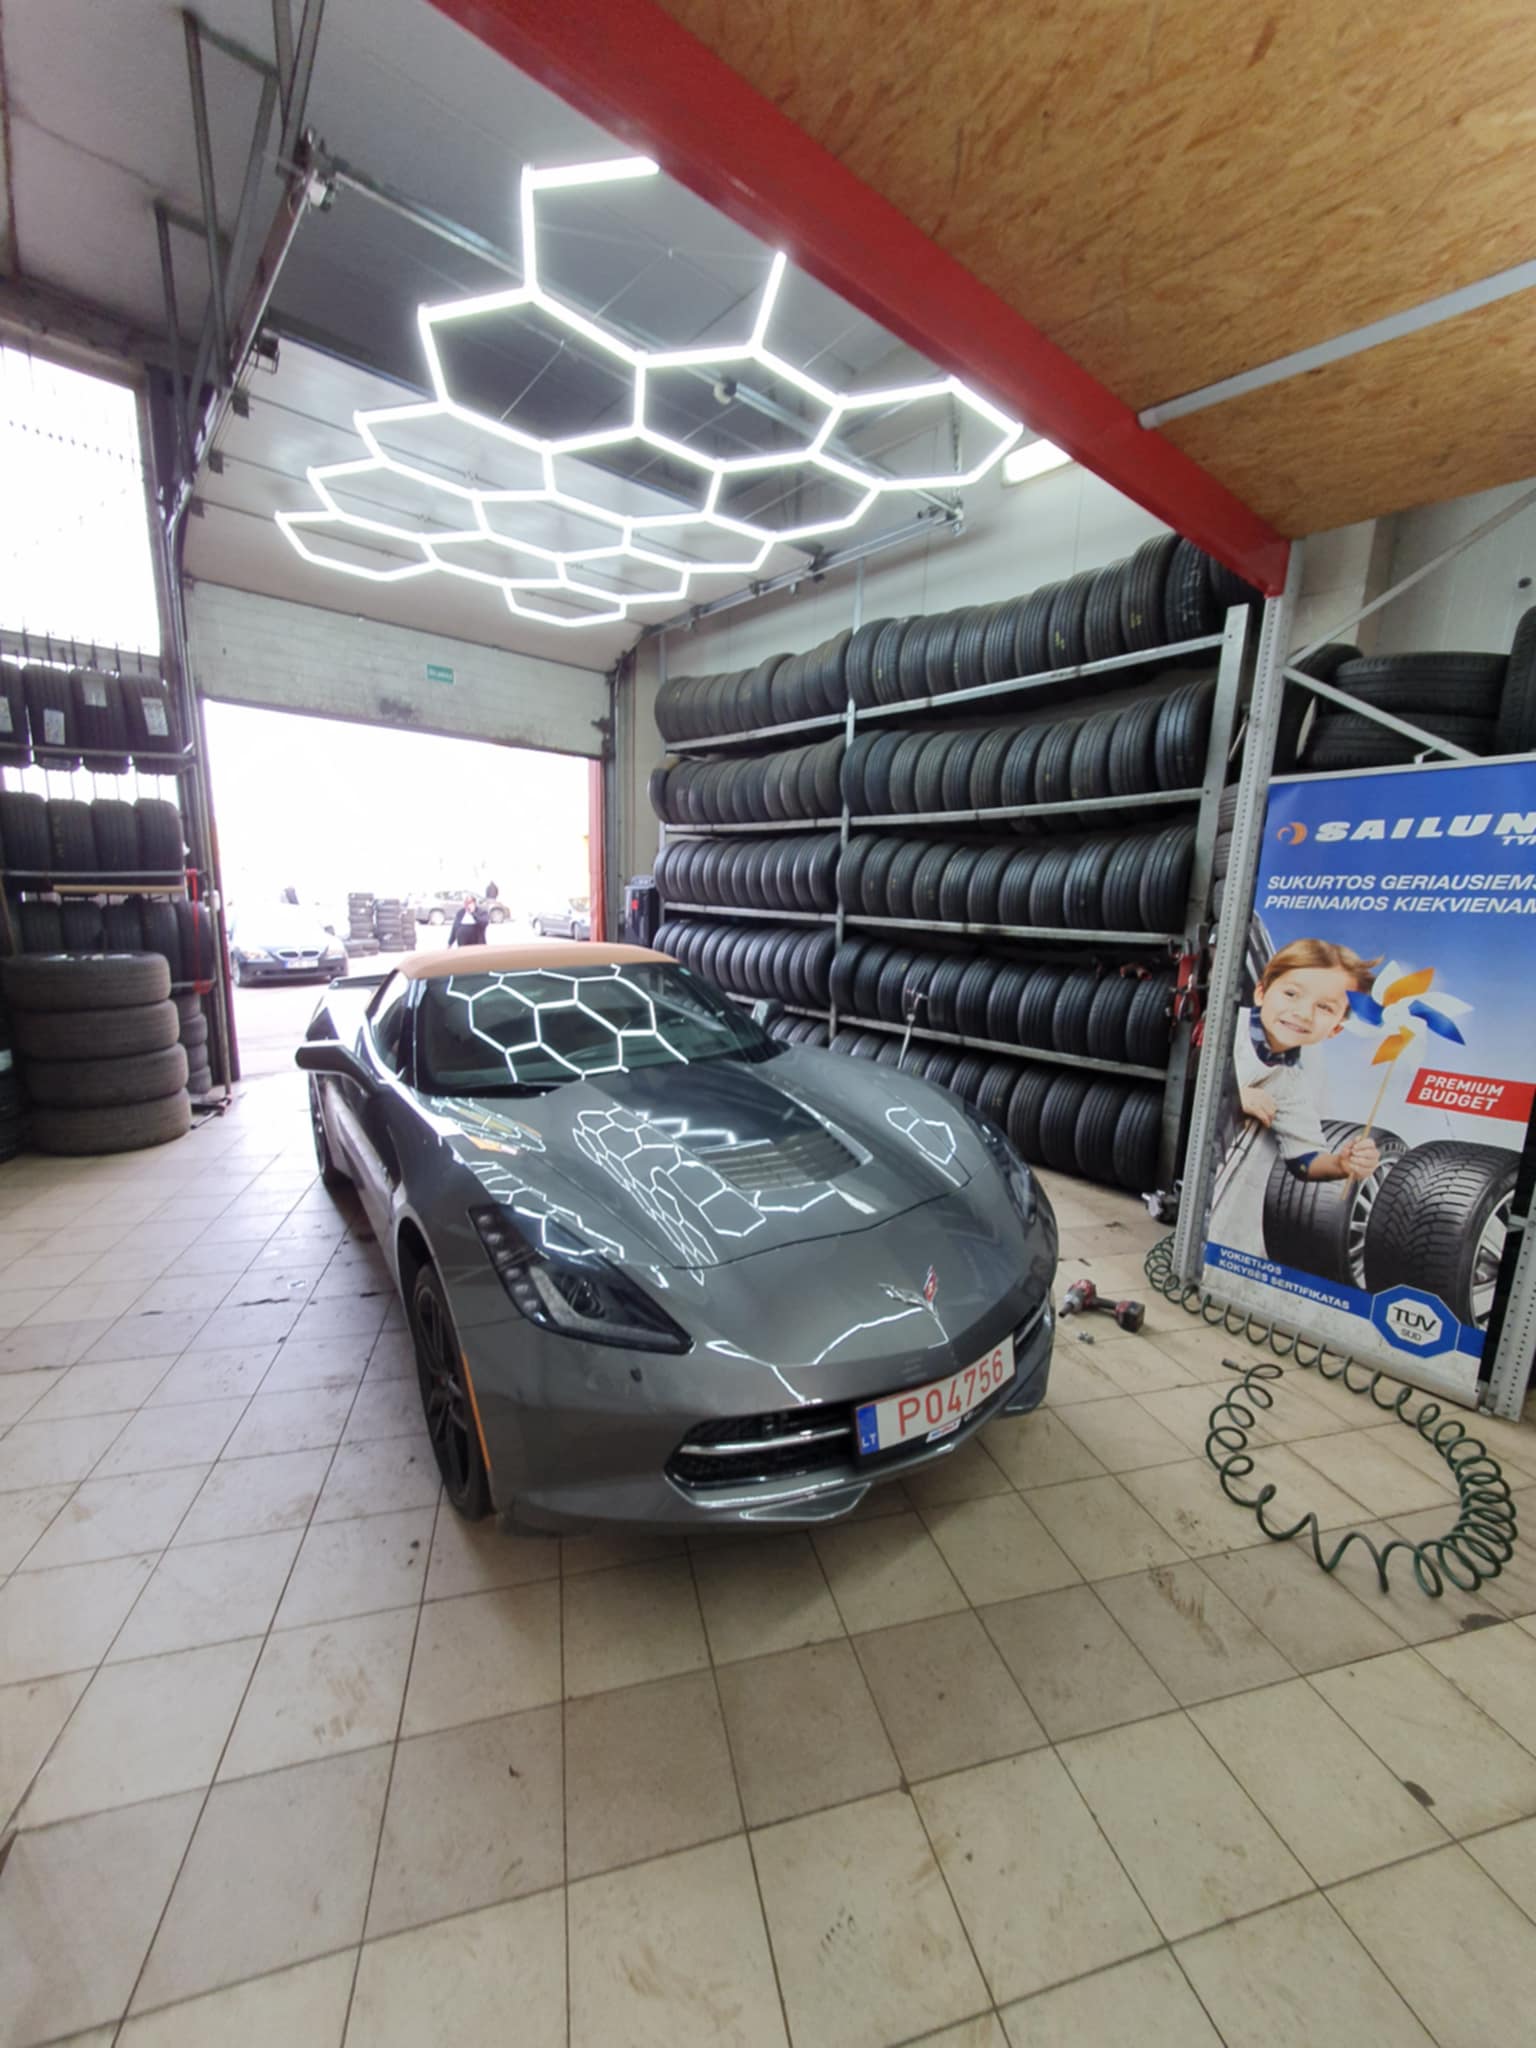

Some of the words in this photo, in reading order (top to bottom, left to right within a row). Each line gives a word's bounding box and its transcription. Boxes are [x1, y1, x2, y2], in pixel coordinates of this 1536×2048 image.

[1314, 811, 1536, 842] SAILUN
[1267, 875, 1376, 890] SUKURTOS
[1380, 874, 1536, 891] GERIAUSIEM
[1264, 896, 1388, 912] PRIEINAMOS
[1424, 1075, 1505, 1097] PREMIUM
[1418, 1087, 1499, 1111] BUDGET
[1220, 1248, 1282, 1275] VOKIETIJOS
[1271, 1276, 1350, 1310] SERTIFIKATAS
[861, 1433, 877, 1447] LT
